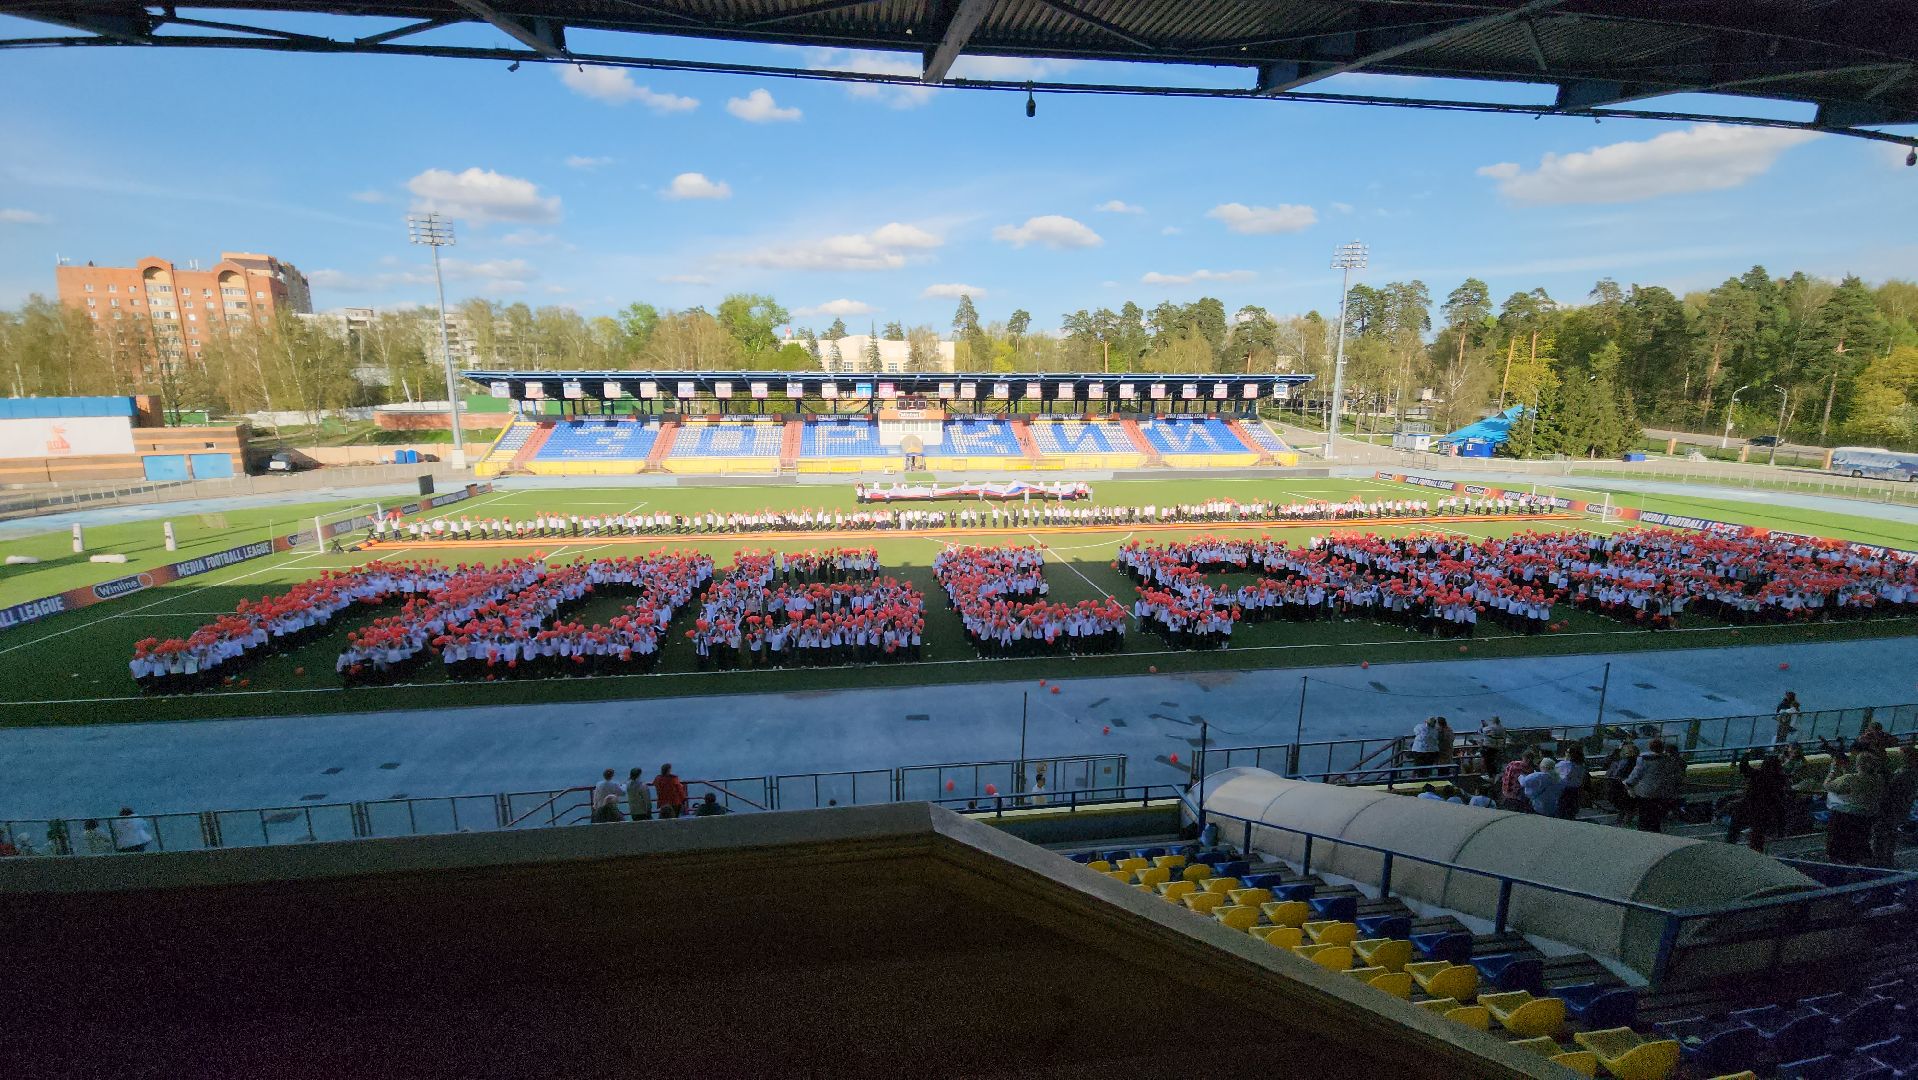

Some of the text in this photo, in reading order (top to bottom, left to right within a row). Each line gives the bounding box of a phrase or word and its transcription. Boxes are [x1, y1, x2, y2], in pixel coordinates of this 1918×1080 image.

[1641, 511, 1666, 524] MEDIA
[1665, 515, 1704, 529] FOOTBALL
[177, 541, 270, 577] MEDIA FOOTBALL LEAGUE
[98, 577, 139, 597] Winline
[20, 596, 65, 622] LEAGUE
